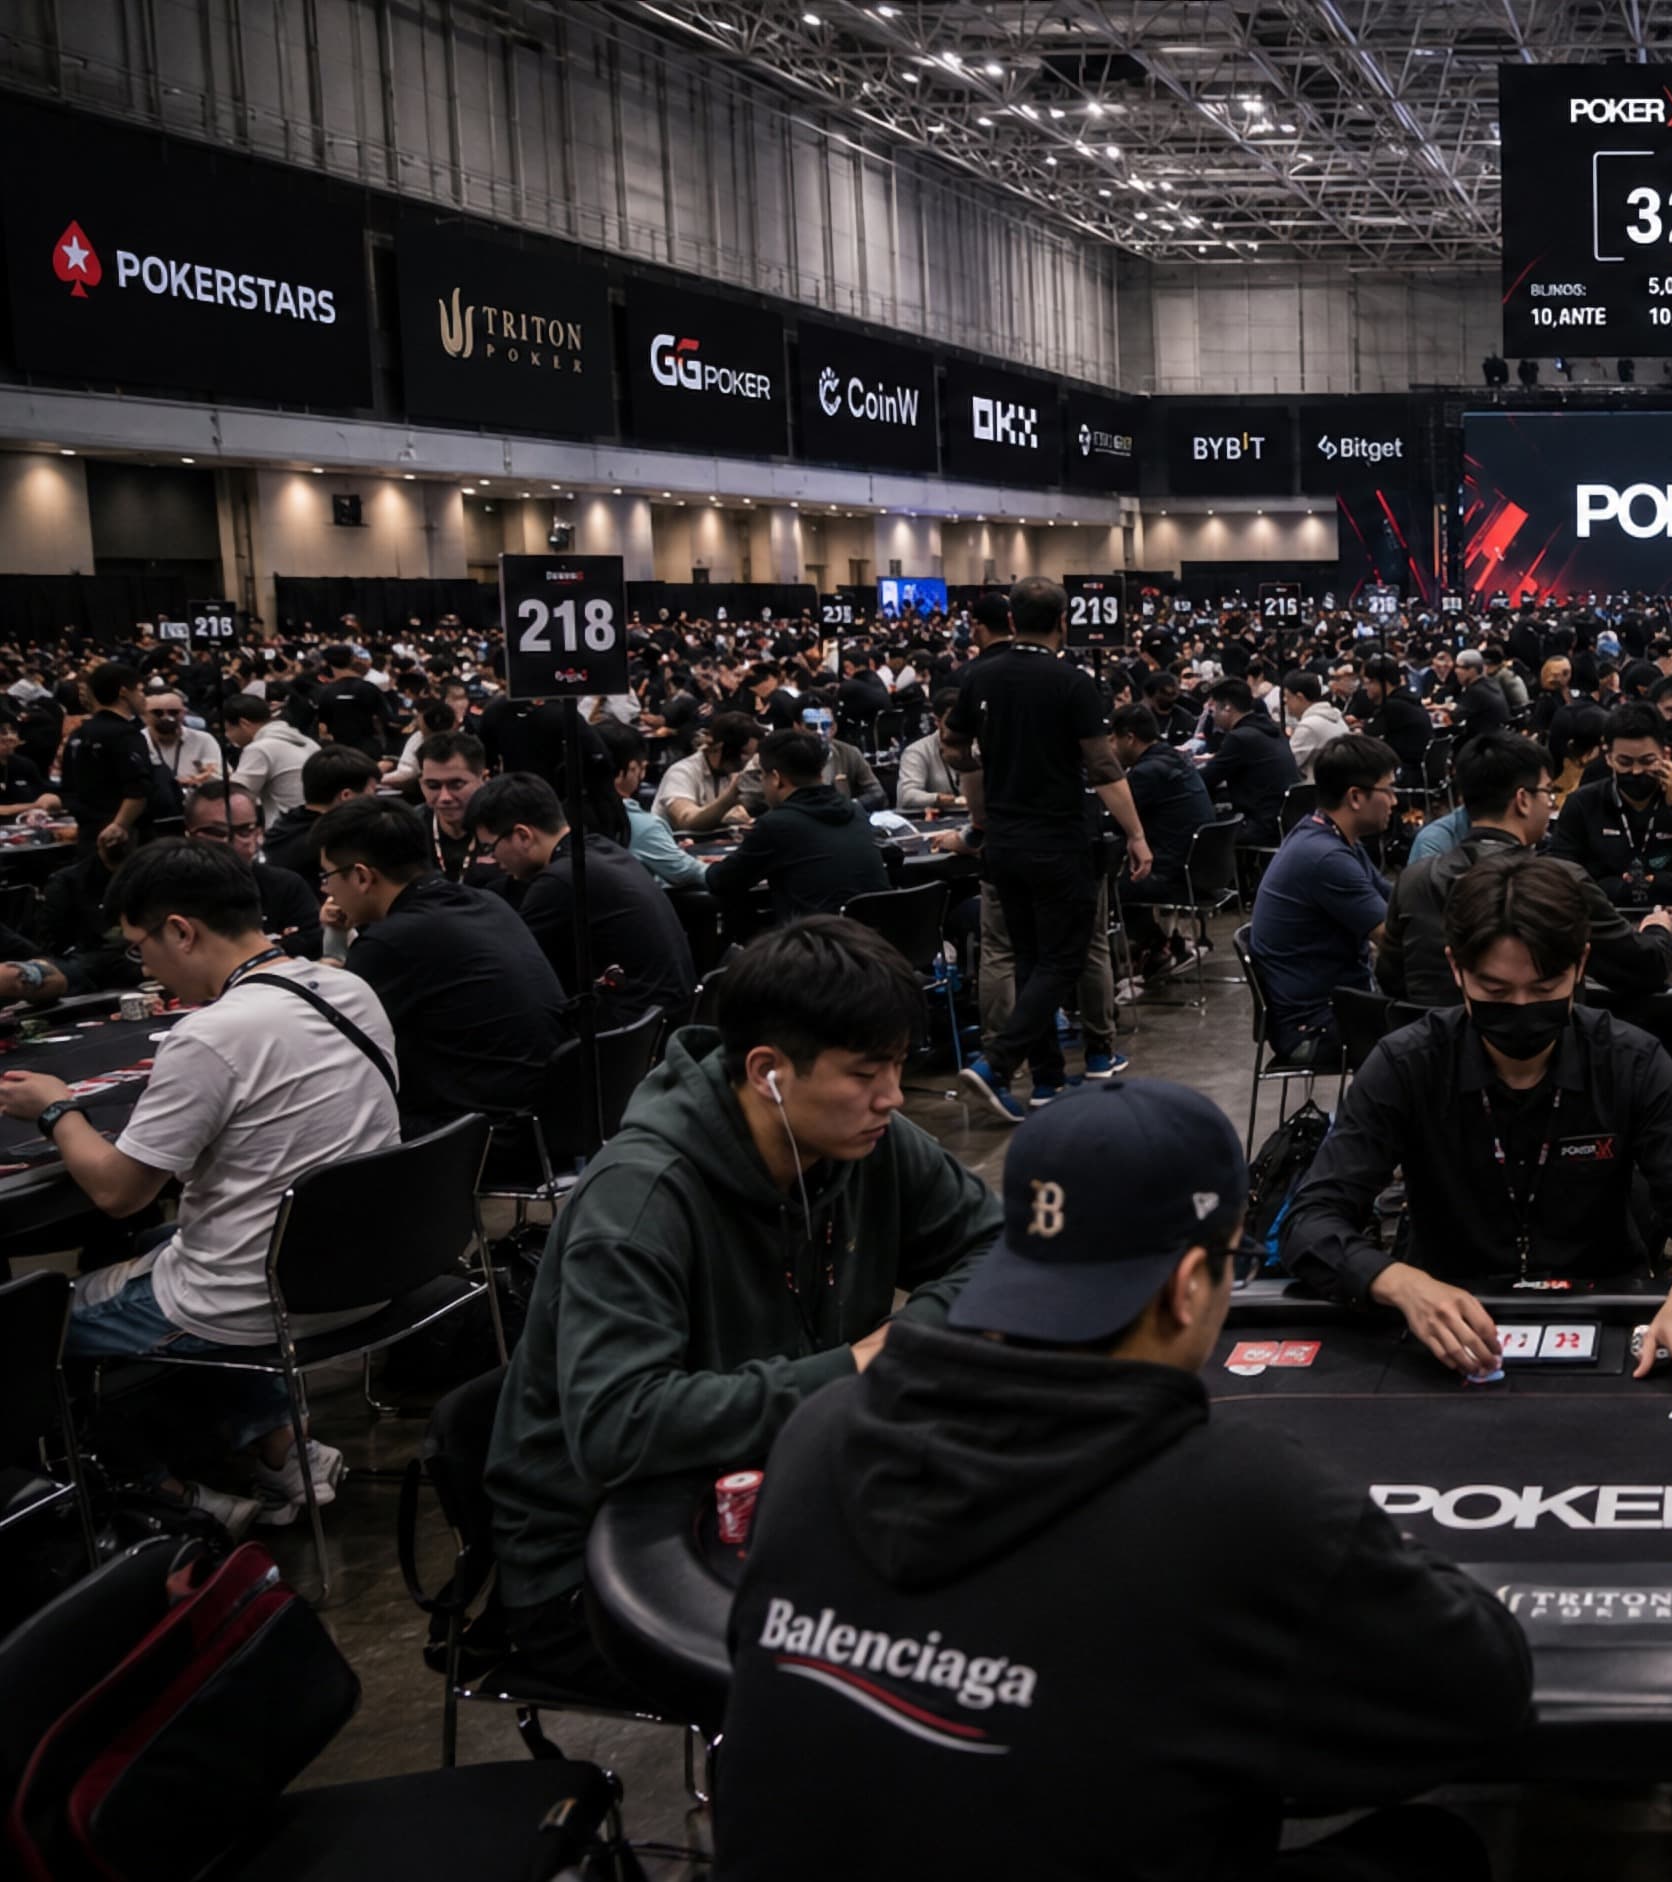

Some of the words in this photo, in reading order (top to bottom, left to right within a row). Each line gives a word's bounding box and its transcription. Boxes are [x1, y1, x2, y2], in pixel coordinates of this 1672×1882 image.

[116, 250, 337, 325] POKERSTARS
[483, 305, 583, 352] TRITON
[846, 376, 919, 427] CoinW
[971, 395, 1039, 449] OKX
[1193, 432, 1266, 460] BYBIT
[1340, 436, 1403, 464] Bitget
[518, 598, 616, 653] 218
[1028, 1178, 1065, 1238] B
[759, 1597, 1038, 1710] Balenciaga
